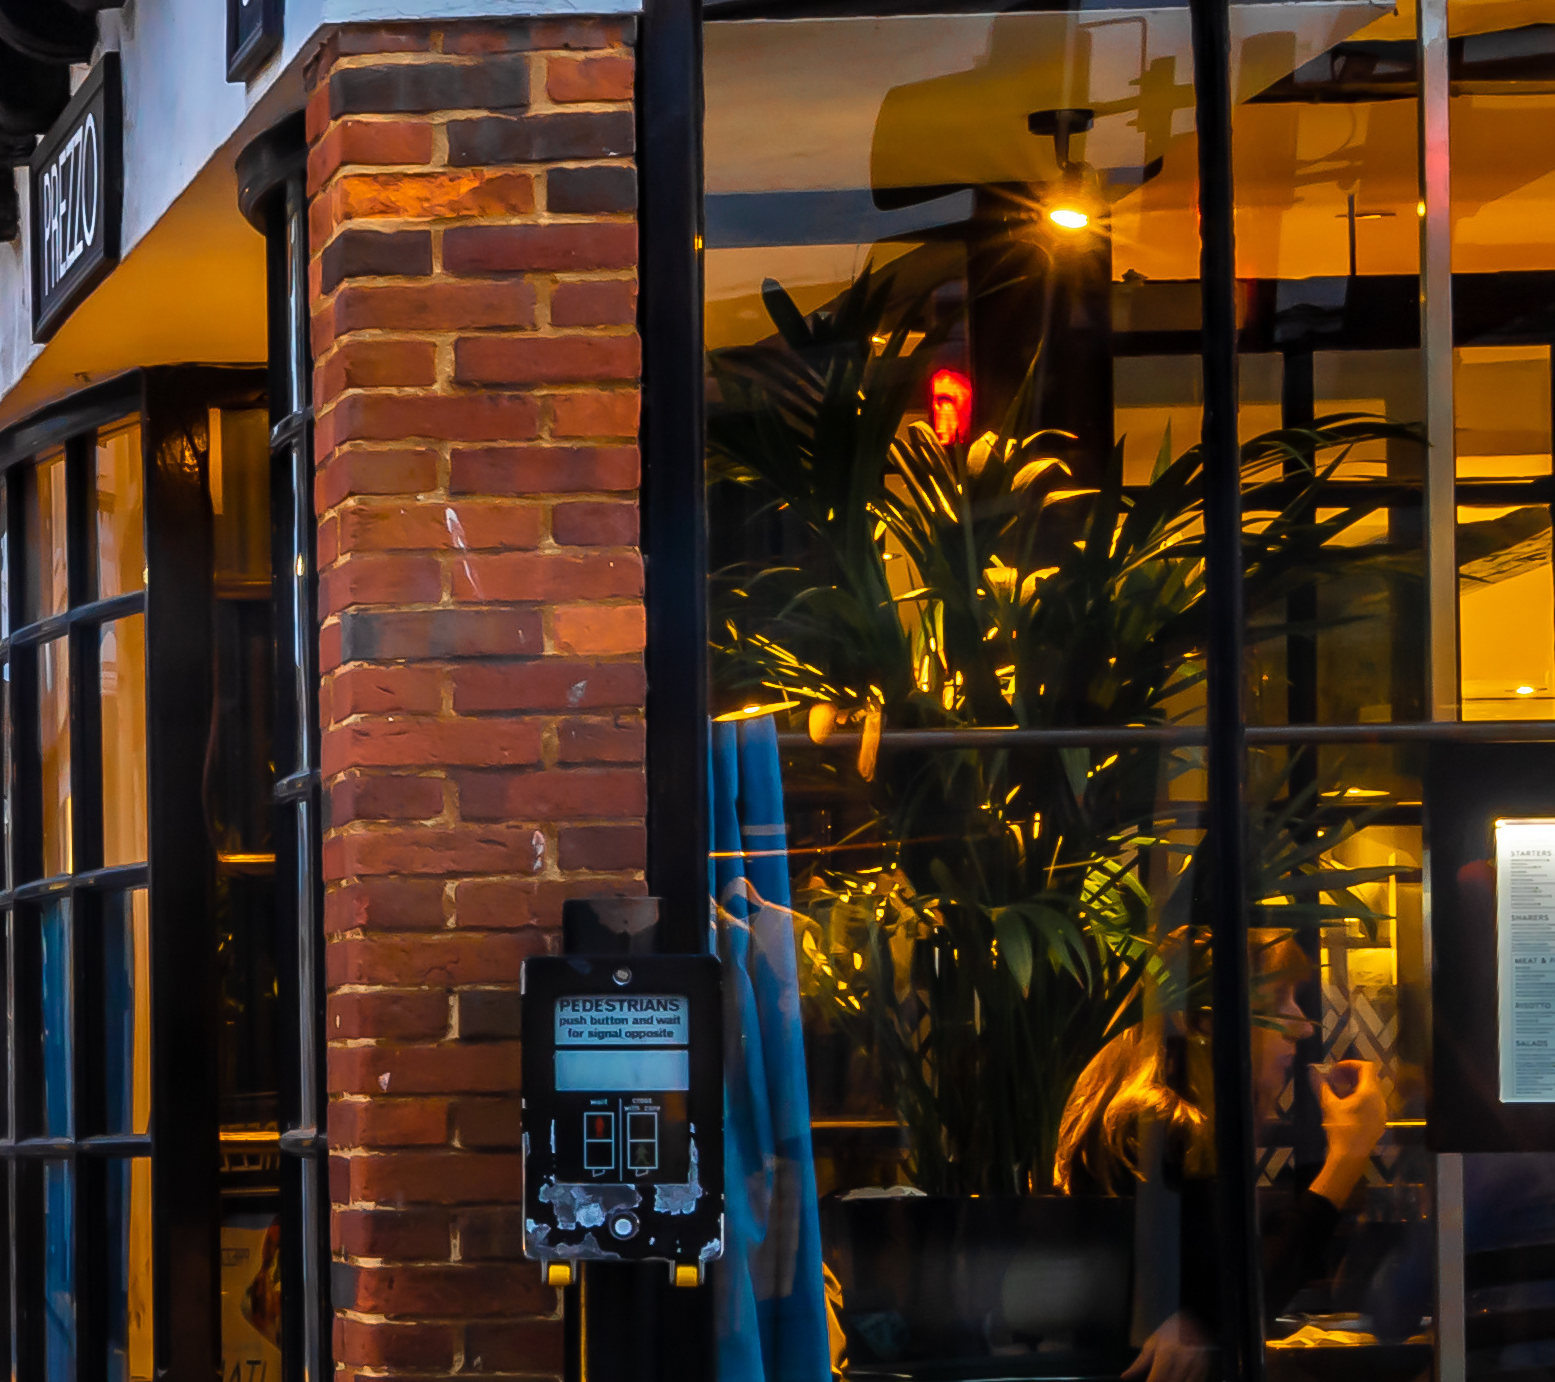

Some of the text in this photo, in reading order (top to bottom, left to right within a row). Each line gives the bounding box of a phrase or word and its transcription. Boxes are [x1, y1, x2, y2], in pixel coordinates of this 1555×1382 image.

[42, 111, 98, 298] PREZZO
[559, 999, 680, 1012] PEDESTRIANS
[559, 1014, 681, 1027] push button and wait
[568, 1028, 674, 1040] for signal opposite
